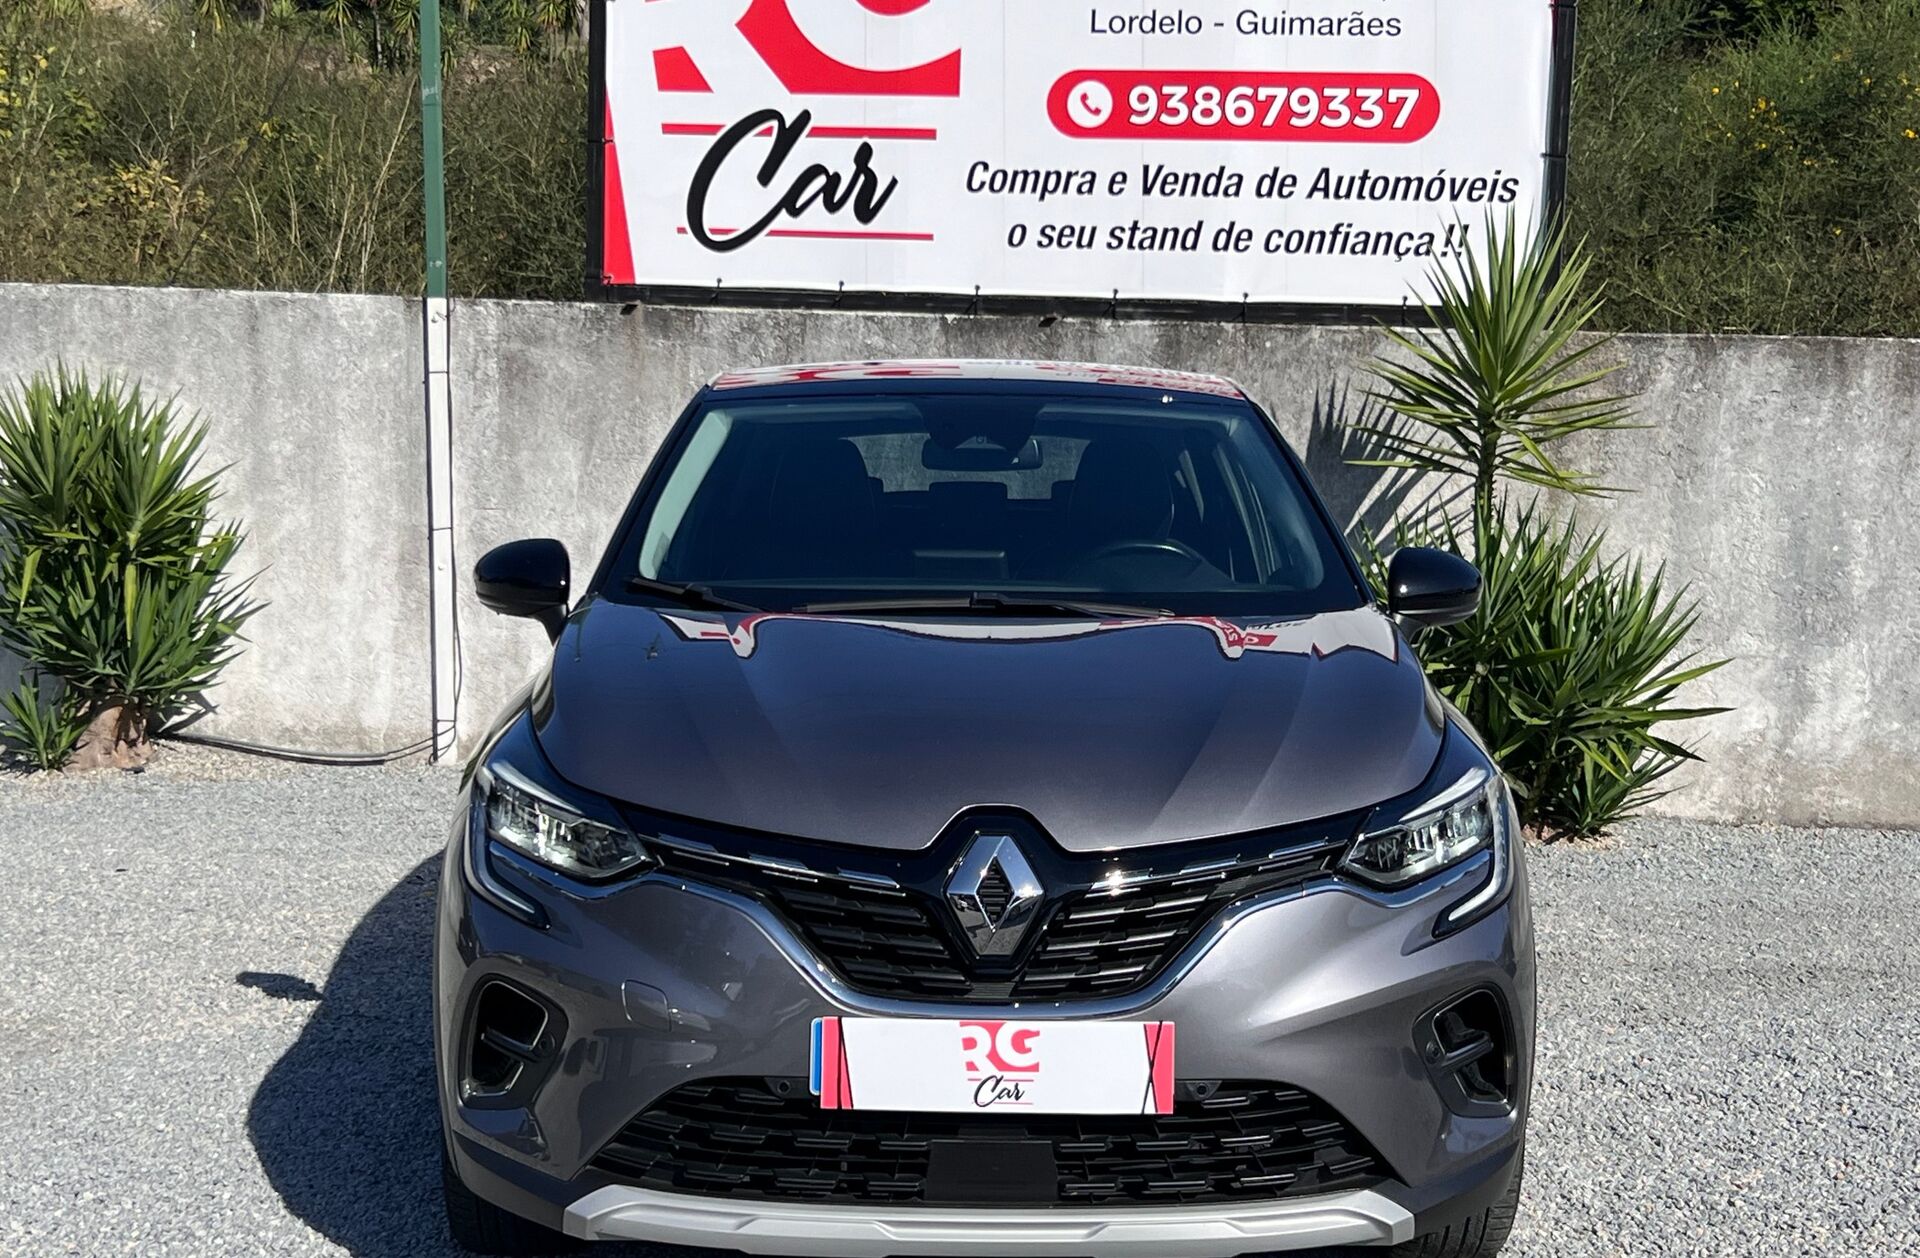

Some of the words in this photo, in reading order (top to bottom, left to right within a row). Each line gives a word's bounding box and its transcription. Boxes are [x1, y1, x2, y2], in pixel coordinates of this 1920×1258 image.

[1090, 9, 1203, 35] Lordelo
[1236, 9, 1402, 37] Guimarães
[1128, 84, 1420, 129] 938679337
[686, 108, 899, 253] Car
[966, 161, 1097, 202] Compra
[1107, 171, 1128, 196] e
[1142, 164, 1244, 198] Venda
[1255, 166, 1298, 199] de
[1306, 167, 1520, 203] Automóveis
[1007, 223, 1027, 248] o
[1037, 224, 1098, 249] seu
[1106, 219, 1204, 252] stand
[1211, 220, 1253, 253] de
[1263, 222, 1436, 262] confiança
[960, 1021, 1040, 1072] RG
[973, 1075, 1025, 1108] Car
